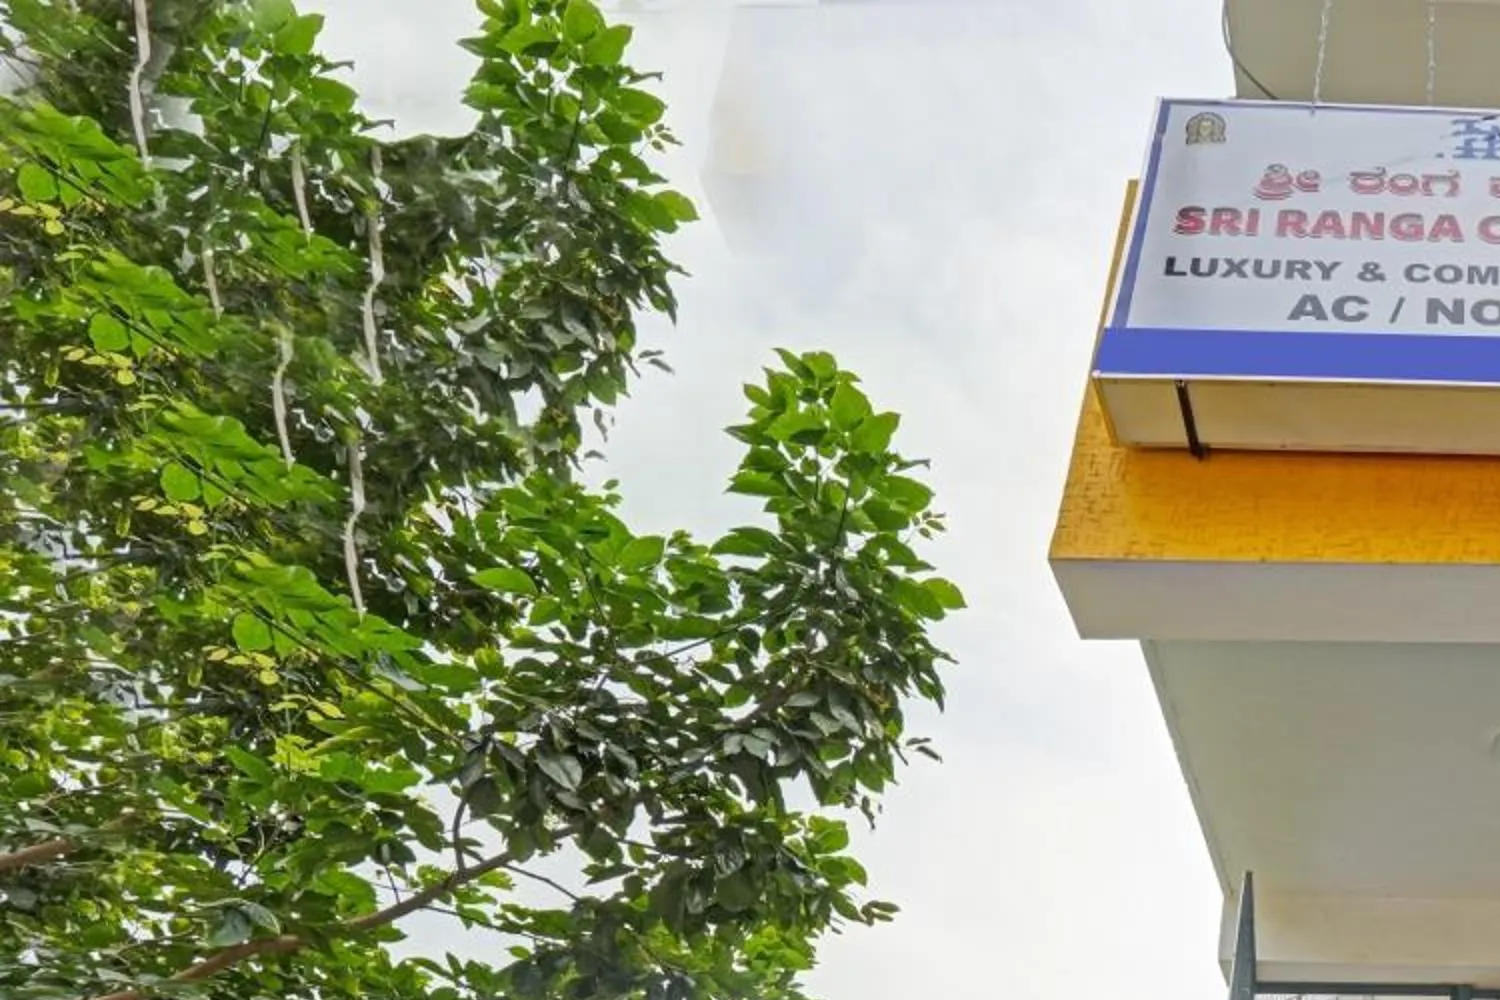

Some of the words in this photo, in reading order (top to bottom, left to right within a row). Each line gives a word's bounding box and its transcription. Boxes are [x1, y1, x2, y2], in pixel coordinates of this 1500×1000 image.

[1253, 163, 1321, 201] ಶ್ರೀ
[1348, 165, 1461, 197] ರಂಗ
[1173, 205, 1260, 237] SRI
[1275, 209, 1465, 243] RANGA
[1164, 256, 1342, 281] LUXURY
[1357, 261, 1387, 283] &
[1287, 294, 1370, 323] AC
[1389, 297, 1406, 324] /
